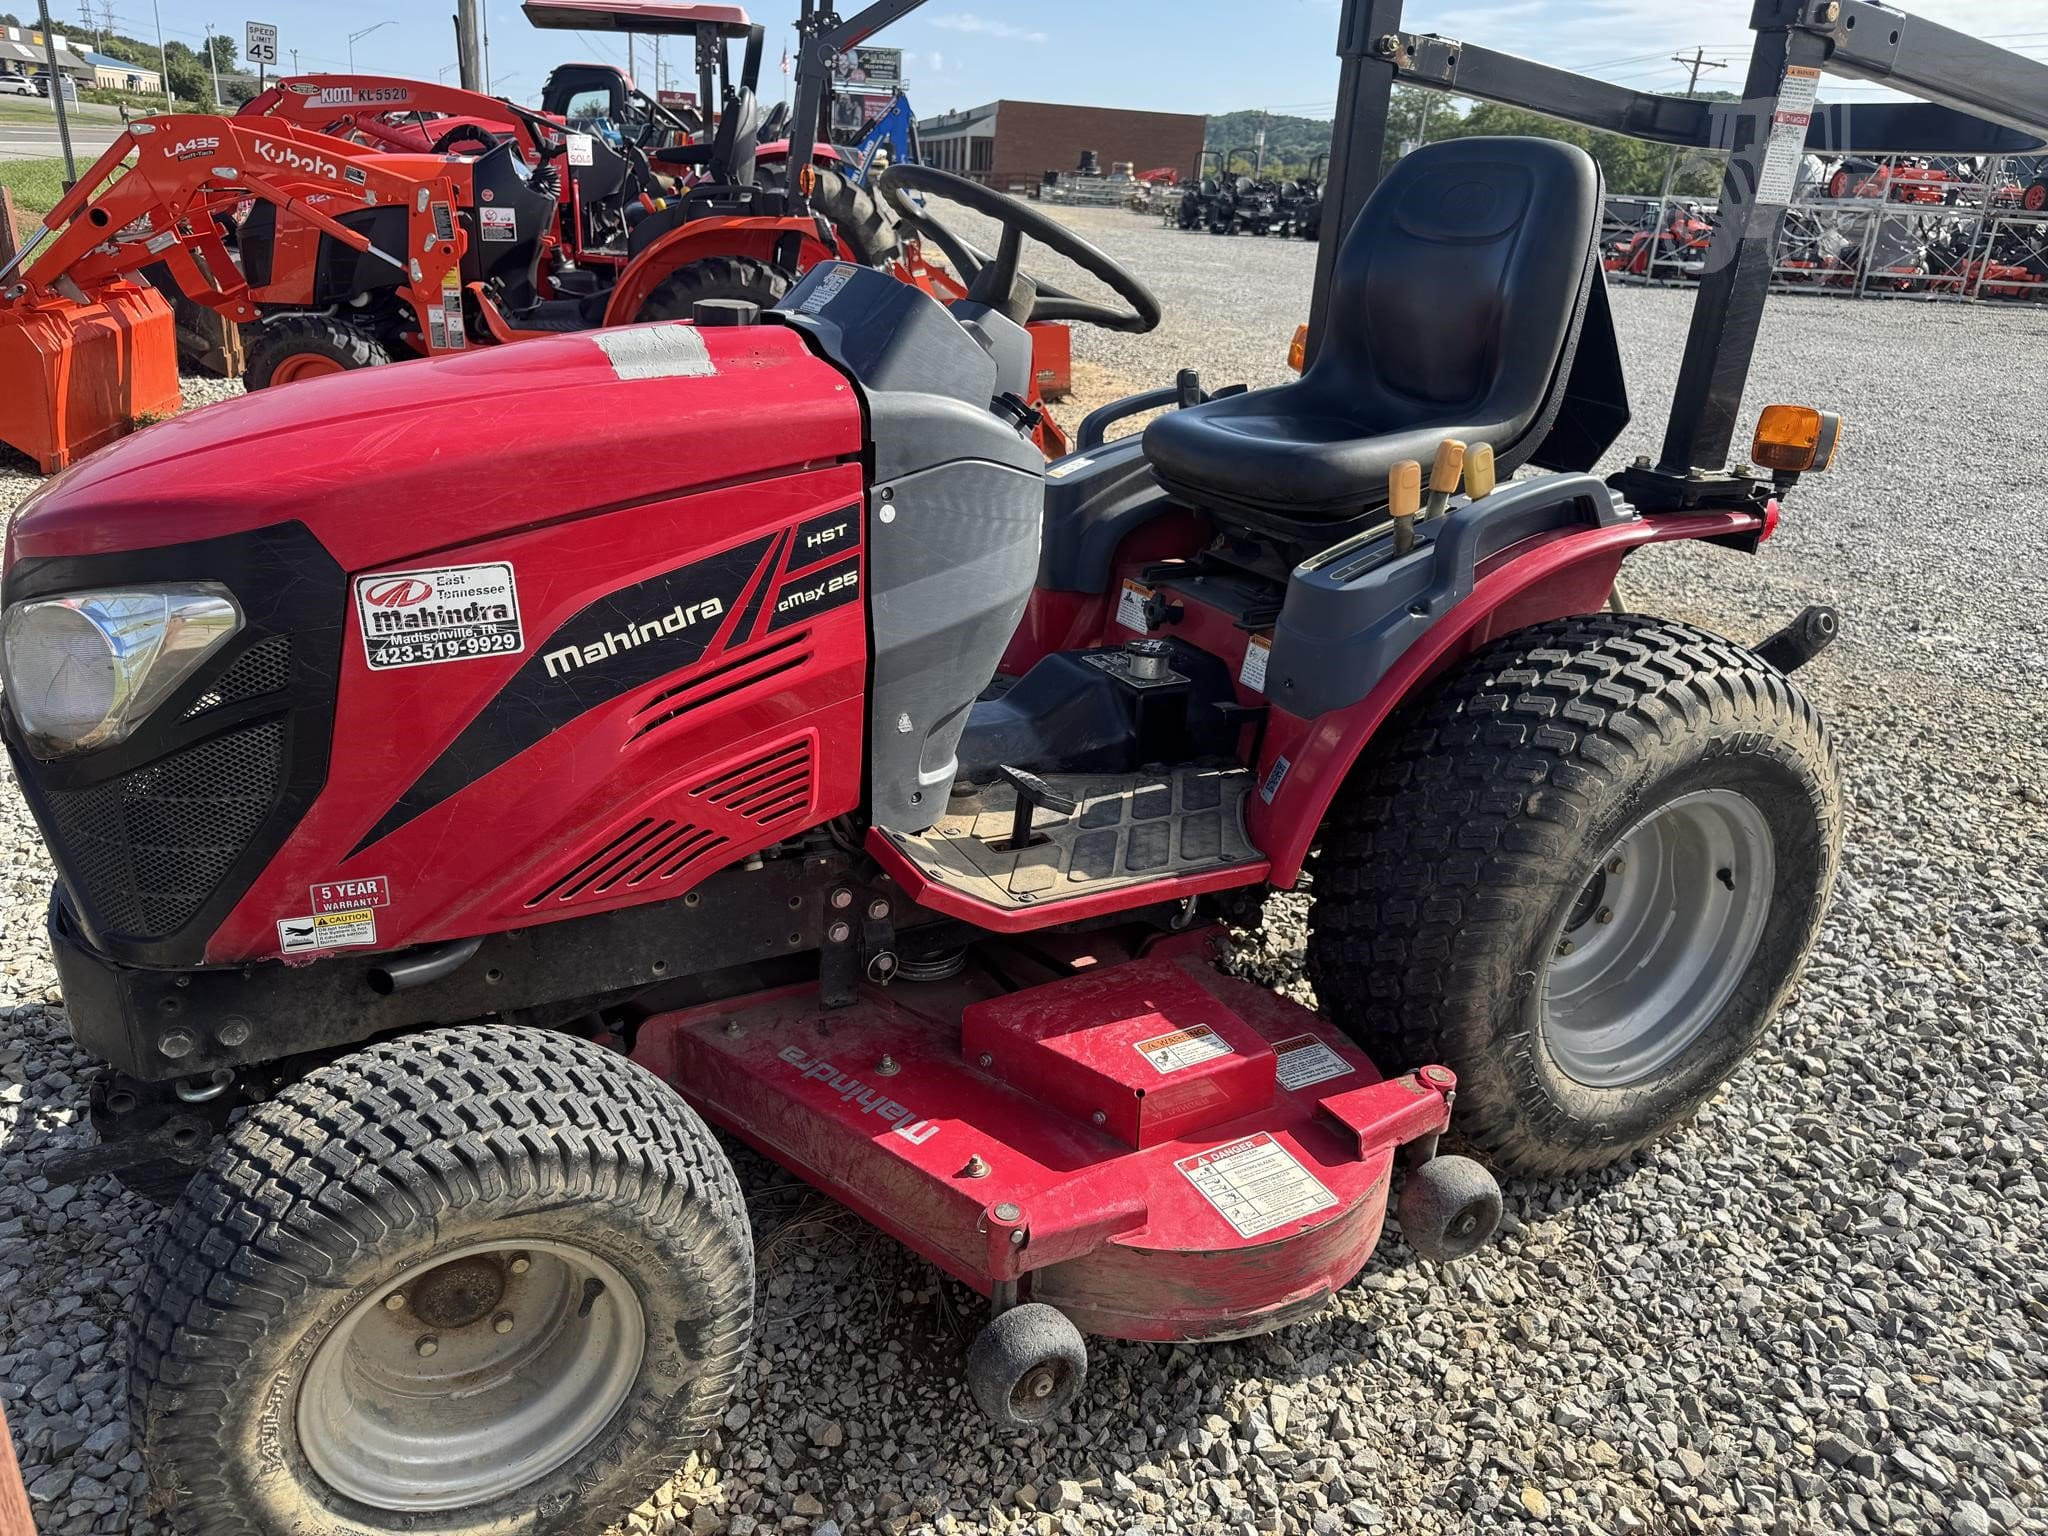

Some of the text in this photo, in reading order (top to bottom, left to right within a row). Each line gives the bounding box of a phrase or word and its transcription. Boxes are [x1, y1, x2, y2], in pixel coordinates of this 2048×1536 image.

[249, 26, 275, 36] SPEED
[251, 35, 272, 43] LIMIT
[249, 44, 274, 60] 45
[321, 87, 353, 103] KIOTI
[163, 137, 220, 159] LA435
[254, 139, 338, 179] Kubota
[807, 523, 848, 548] HST
[436, 574, 466, 587] East
[436, 585, 505, 600] Tennessee
[778, 570, 858, 612] eMax 25
[372, 601, 508, 633] Mahindra
[390, 623, 498, 646] Madisonville, TN
[543, 597, 723, 679] Mahindra
[375, 633, 516, 664] 423-519-9929
[321, 880, 378, 900] 5 YEAR
[323, 897, 379, 911] WARRANTY
[329, 912, 369, 924] CAUTION
[1158, 1028, 1207, 1047] WARNING
[777, 1045, 940, 1146] Mahindra
[1210, 1141, 1256, 1161] DANGER
